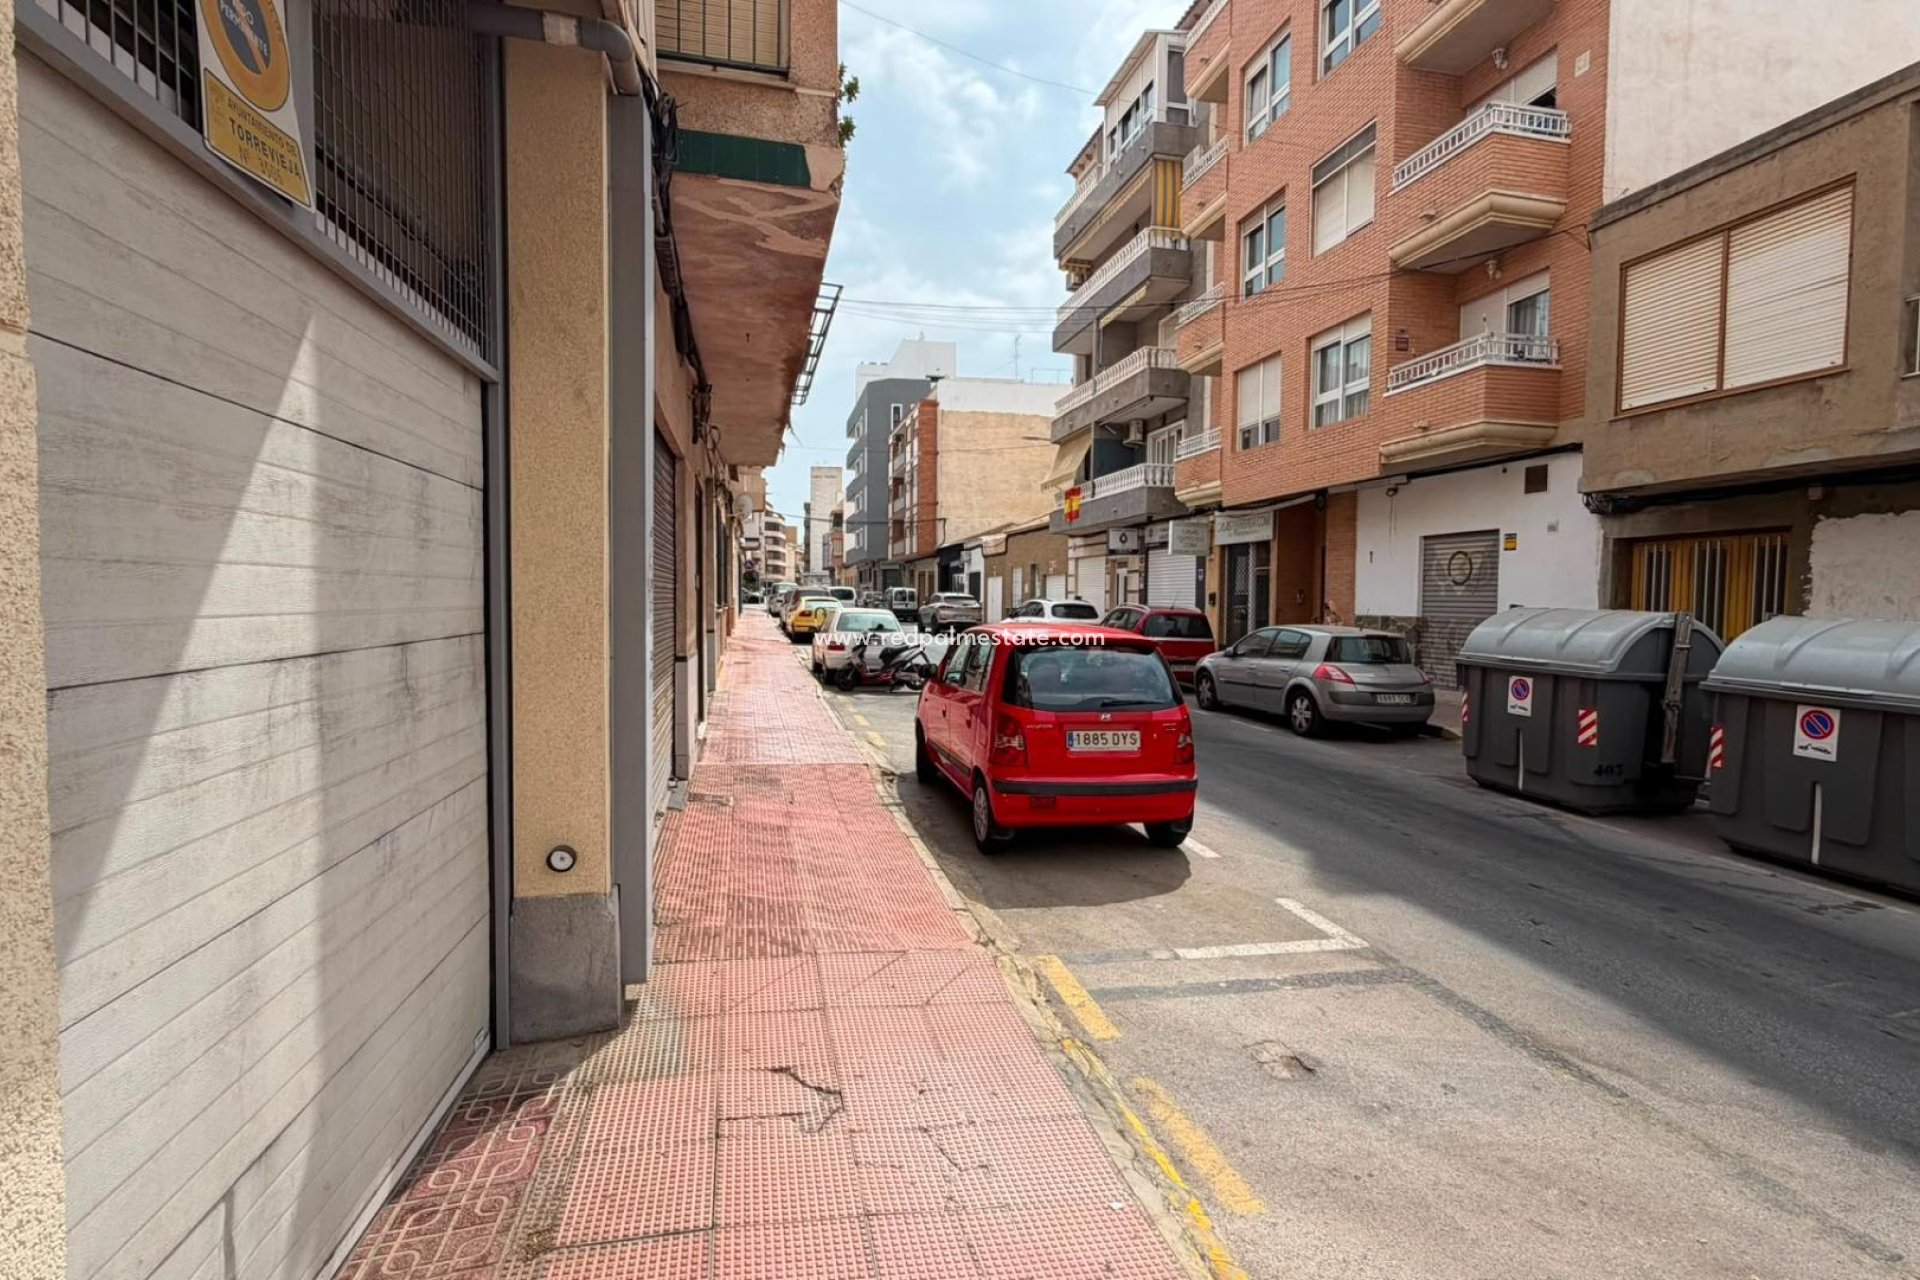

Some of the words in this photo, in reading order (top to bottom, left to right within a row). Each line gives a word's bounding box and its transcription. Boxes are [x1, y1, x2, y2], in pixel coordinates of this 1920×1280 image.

[229, 116, 302, 181] TORREVIEJA
[1075, 732, 1109, 746] 1885
[1112, 732, 1138, 747] DYS
